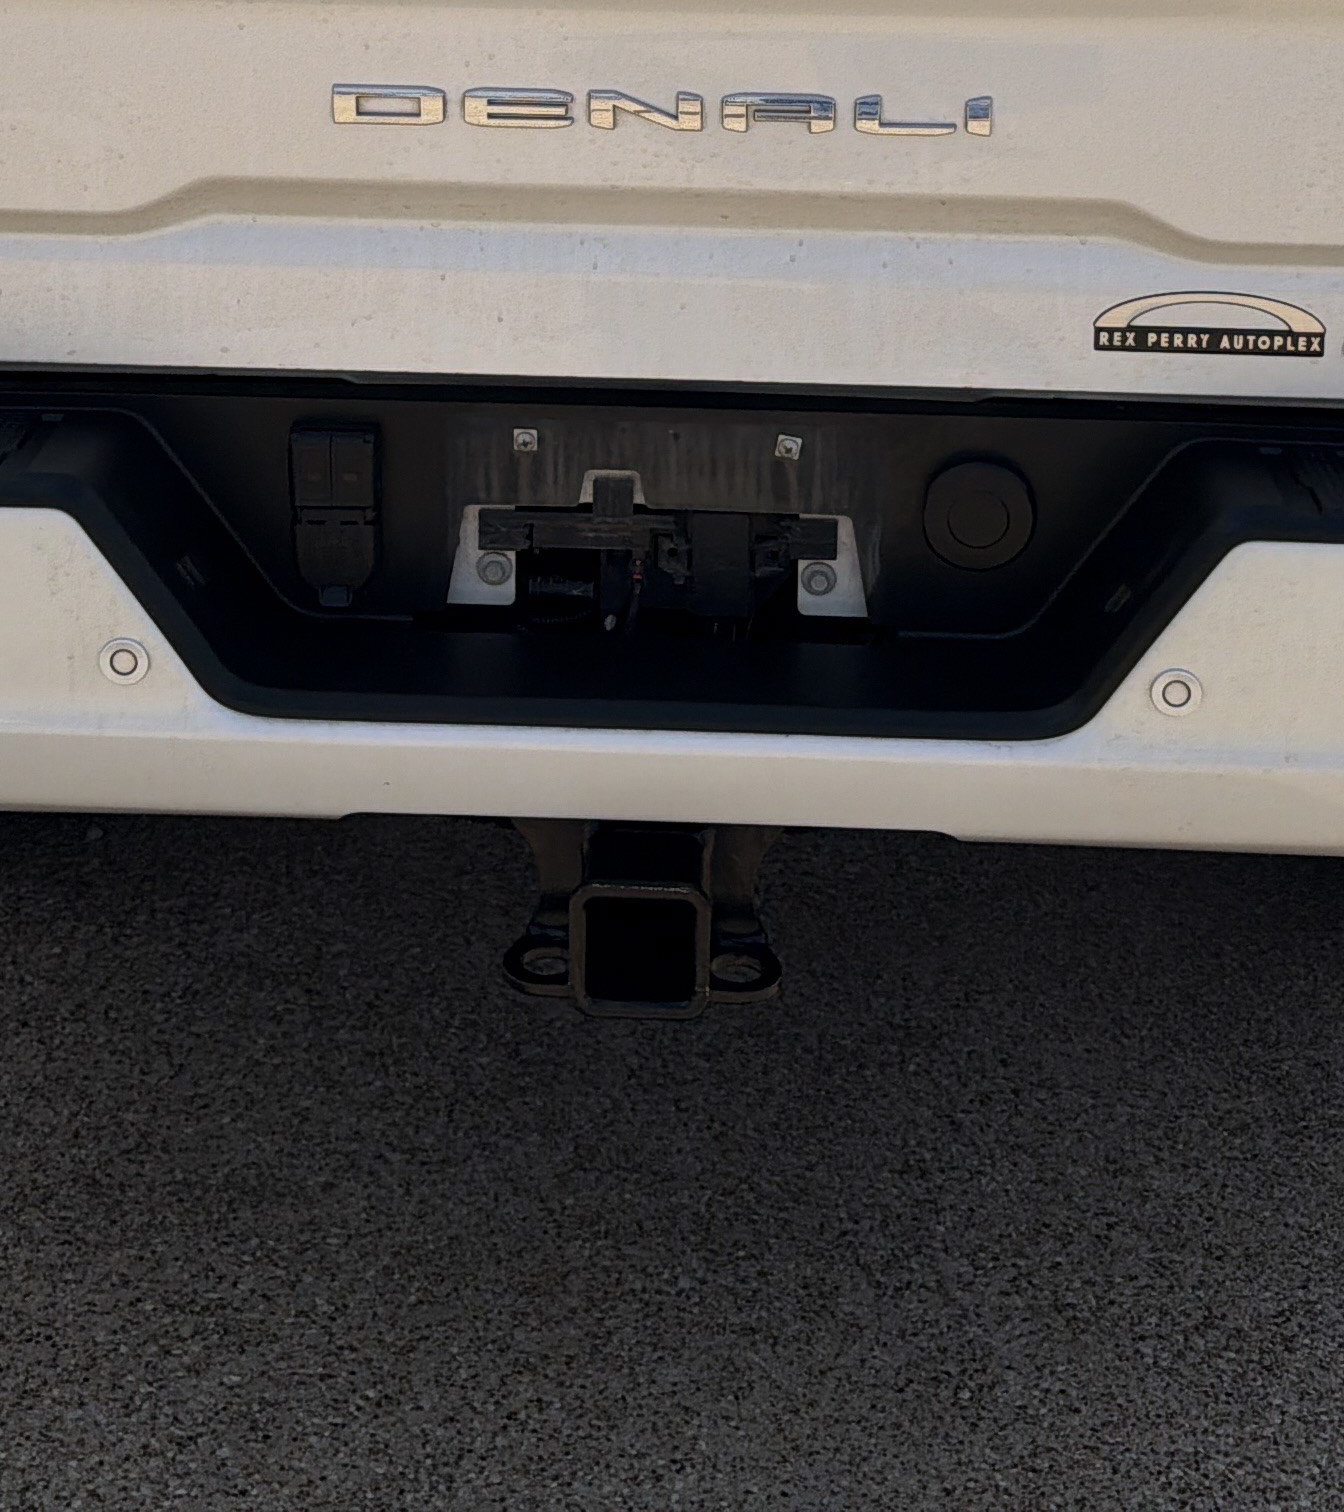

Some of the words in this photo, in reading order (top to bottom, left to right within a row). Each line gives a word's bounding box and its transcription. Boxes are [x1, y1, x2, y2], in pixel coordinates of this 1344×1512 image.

[332, 84, 993, 137] DENALI
[1099, 331, 1136, 347] REX
[1147, 332, 1210, 349] PERRY
[1219, 335, 1321, 352] AUTOPLEX
